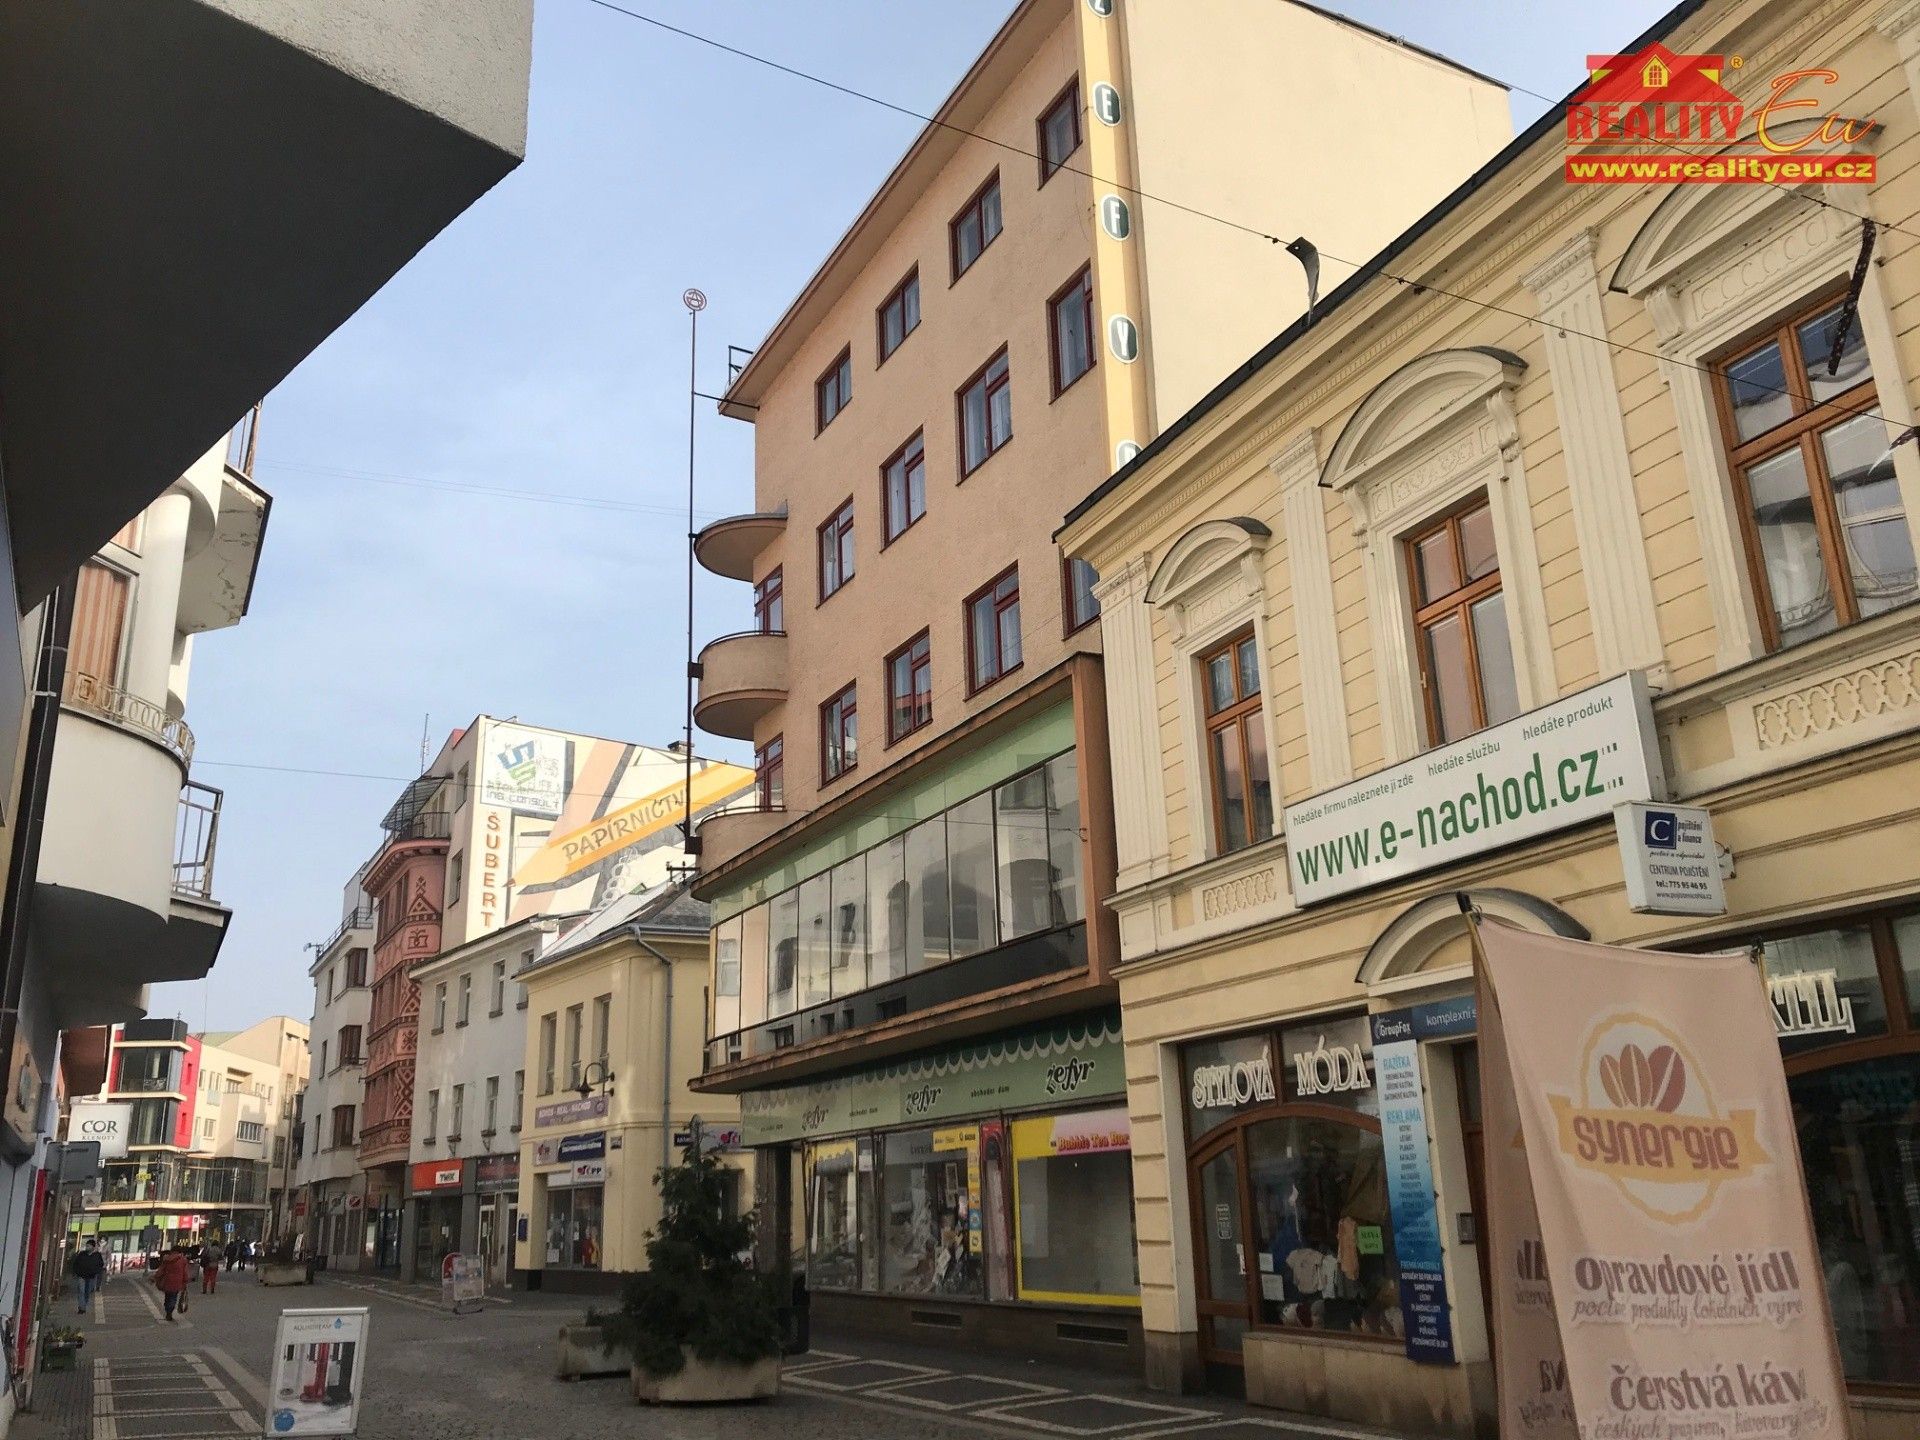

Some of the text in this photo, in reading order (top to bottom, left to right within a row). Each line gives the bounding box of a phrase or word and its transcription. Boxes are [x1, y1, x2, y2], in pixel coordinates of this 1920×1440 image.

[1522, 696, 1614, 741] hledáte produkt
[1427, 741, 1501, 777] hledáte službu
[1293, 808, 1323, 827] hledáte
[1323, 799, 1347, 816] firmu
[1347, 782, 1390, 807] naleznete
[1397, 774, 1414, 788] zde
[1296, 748, 1606, 886] www.e-nachod.cz
[562, 788, 689, 861] PAPÍRNICTV
[1650, 819, 1671, 841] C
[481, 812, 501, 929] ŠUBERT
[1649, 864, 1679, 876] CENTRUM
[1425, 1006, 1471, 1027] komplexní
[1046, 1056, 1095, 1095] zefyr
[1192, 1034, 1372, 1109] STYLOVÁ MÓDA
[905, 1084, 942, 1116] zefyr
[81, 1120, 118, 1133] COR
[1058, 1134, 1090, 1151] Bubble
[1091, 1133, 1109, 1149] Tea
[1573, 1115, 1740, 1171] synergie
[1574, 1253, 1730, 1302] opravdové
[1631, 1296, 1689, 1328] produkty
[1610, 1363, 1739, 1413] čerstvá
